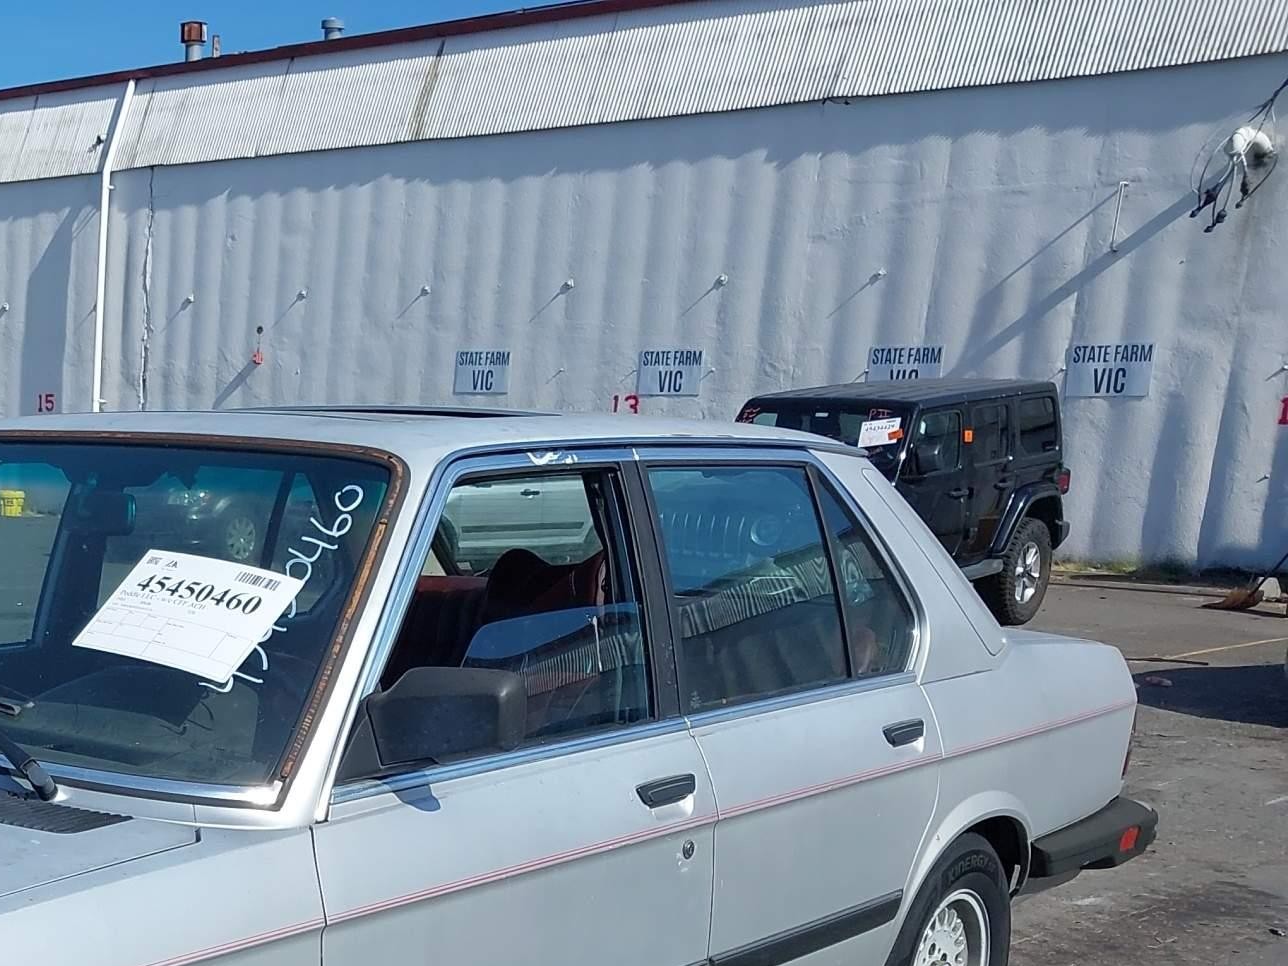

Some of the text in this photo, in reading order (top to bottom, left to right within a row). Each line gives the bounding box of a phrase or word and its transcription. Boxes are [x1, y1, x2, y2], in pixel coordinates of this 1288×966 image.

[459, 351, 510, 366] STATE FARM
[642, 350, 703, 366] STATE FARM
[872, 347, 942, 365] STATE FARM
[1073, 344, 1153, 363] STATE FARM
[472, 370, 494, 391] VIC
[658, 370, 683, 393] VIC
[1093, 367, 1126, 394] VIC
[38, 394, 55, 412] 15
[137, 574, 262, 615] 45450460
